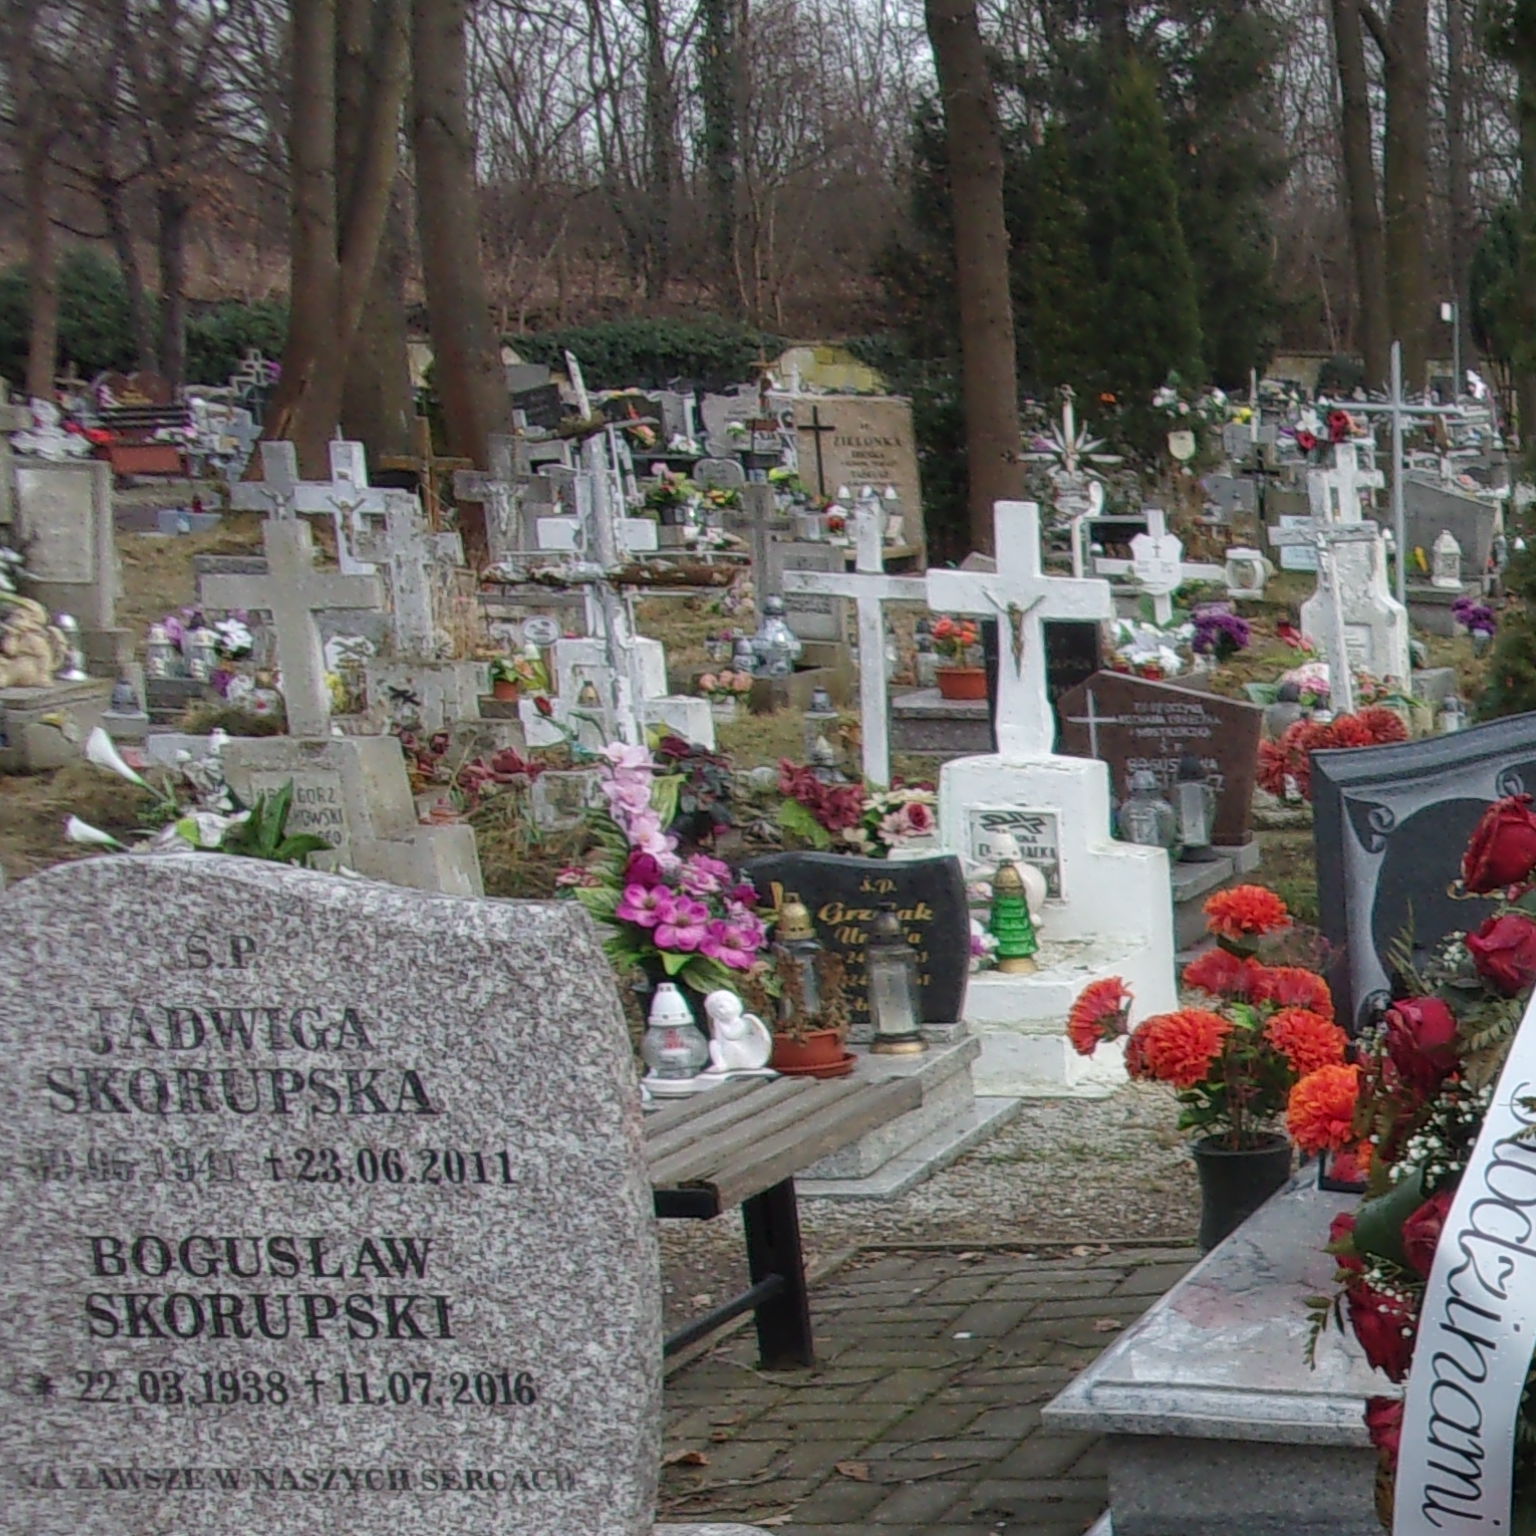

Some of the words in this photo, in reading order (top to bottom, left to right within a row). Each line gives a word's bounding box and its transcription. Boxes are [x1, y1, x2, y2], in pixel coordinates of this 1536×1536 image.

[90, 1004, 375, 1055] JADWIGA
[46, 1066, 440, 1116] SKORUPSKA
[295, 1148, 519, 1185] 23.06.2011
[86, 1233, 435, 1282] BOGUSŁAW
[84, 1293, 457, 1342] SKORUPSKI
[74, 1368, 290, 1405] 22.03.1938
[334, 1367, 537, 1406] 11.07.2016
[213, 1467, 242, 1490] W
[250, 1467, 413, 1492] NASZYCH
